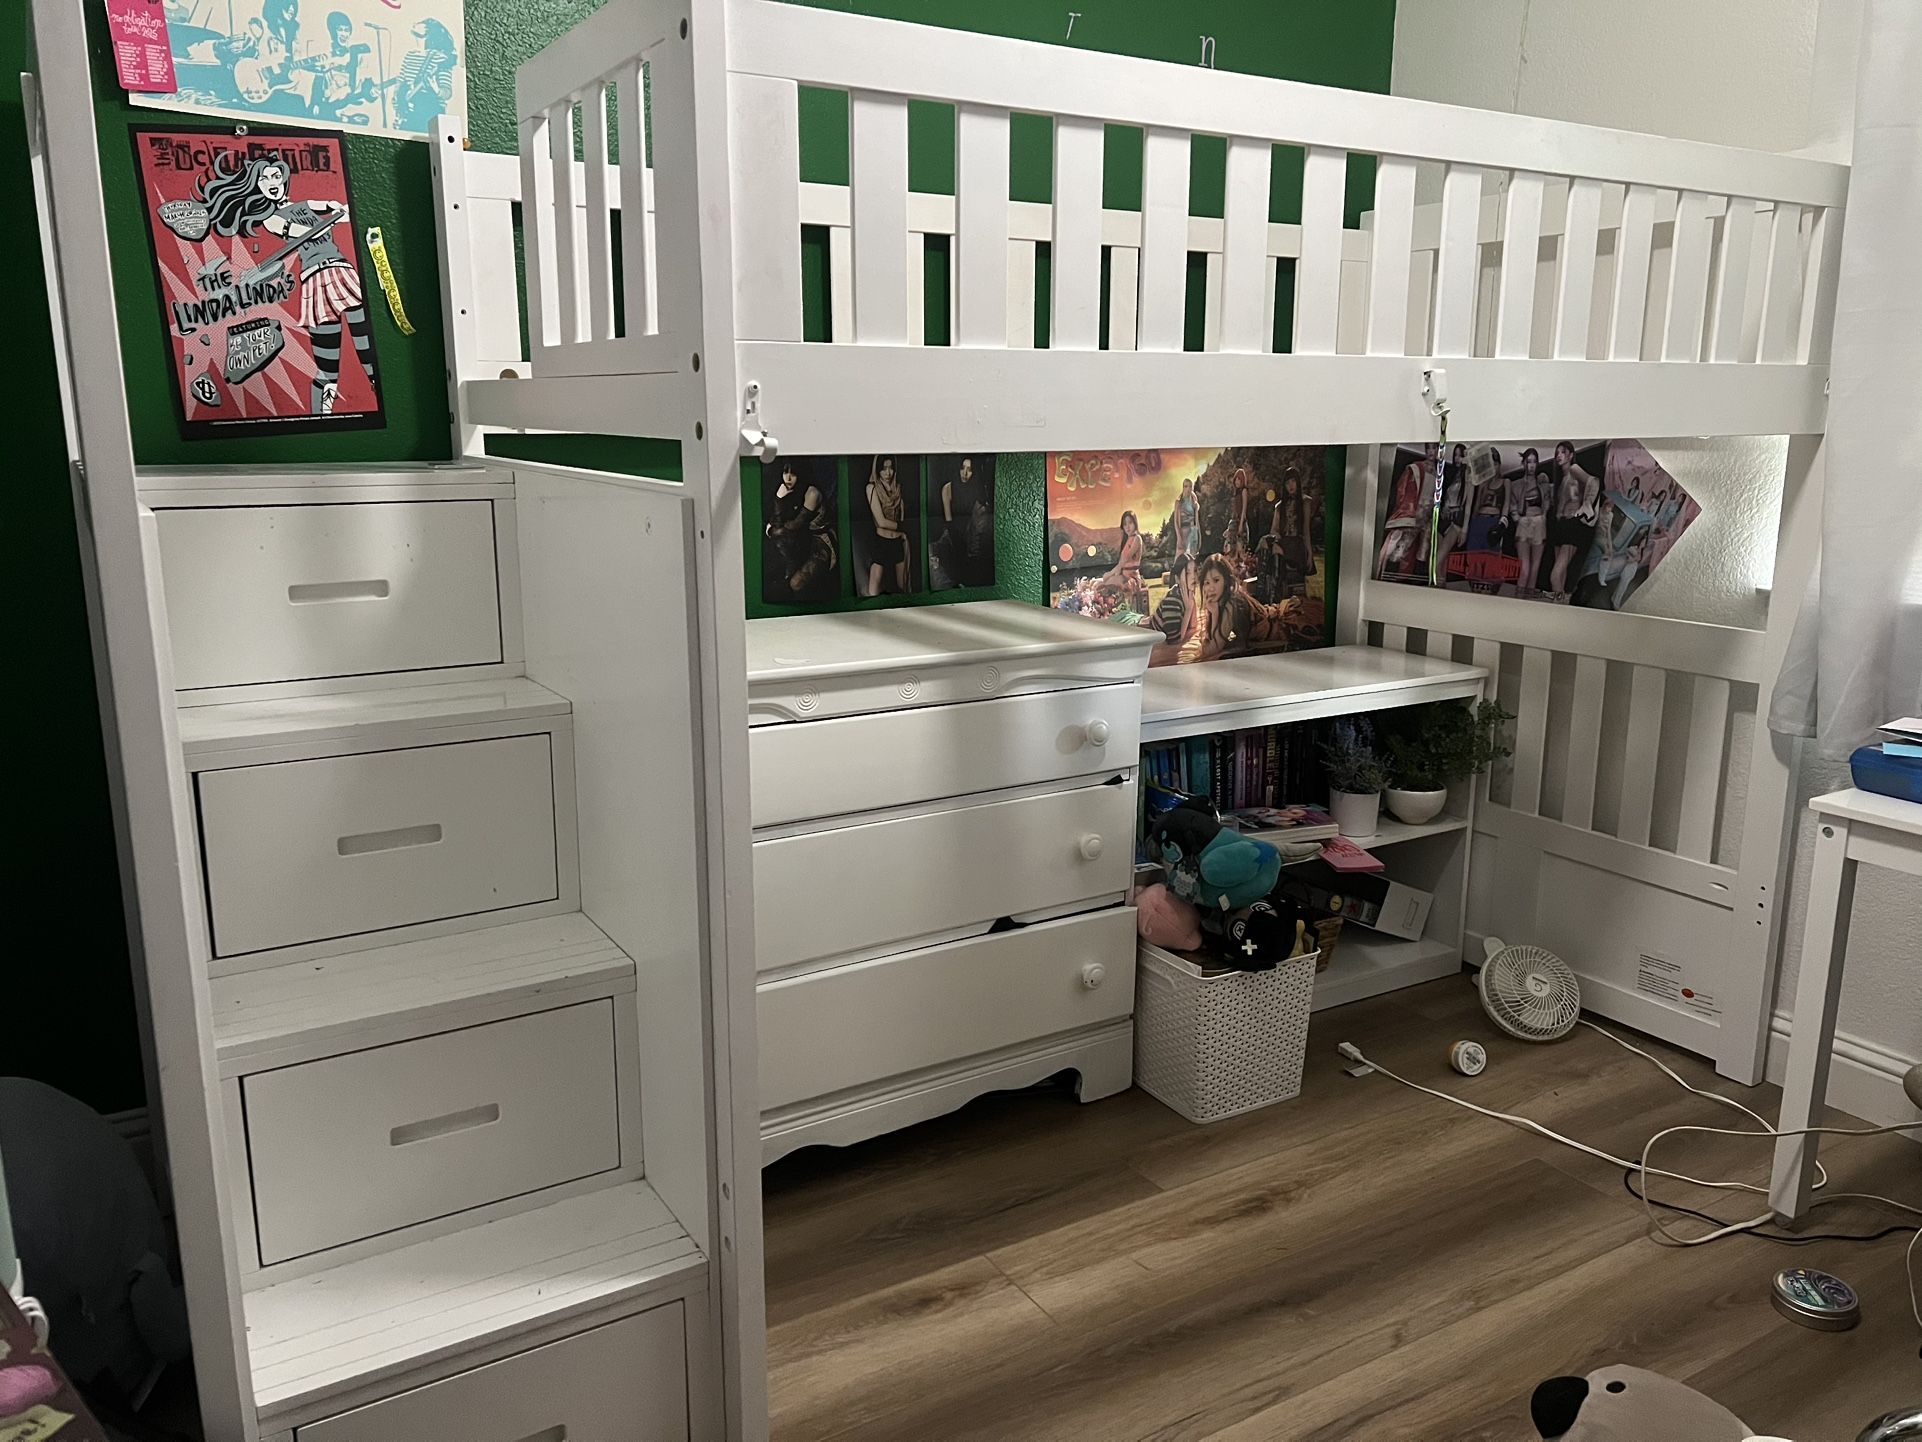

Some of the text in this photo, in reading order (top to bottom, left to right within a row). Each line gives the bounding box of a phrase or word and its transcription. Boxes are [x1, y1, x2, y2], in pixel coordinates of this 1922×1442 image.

[290, 207, 308, 217] THE
[197, 270, 232, 292] THE
[172, 271, 297, 335] LINDA LINDA'S
[229, 319, 270, 334] FEATURING
[244, 327, 271, 346] YOUR
[228, 332, 276, 371] OWN PET!
